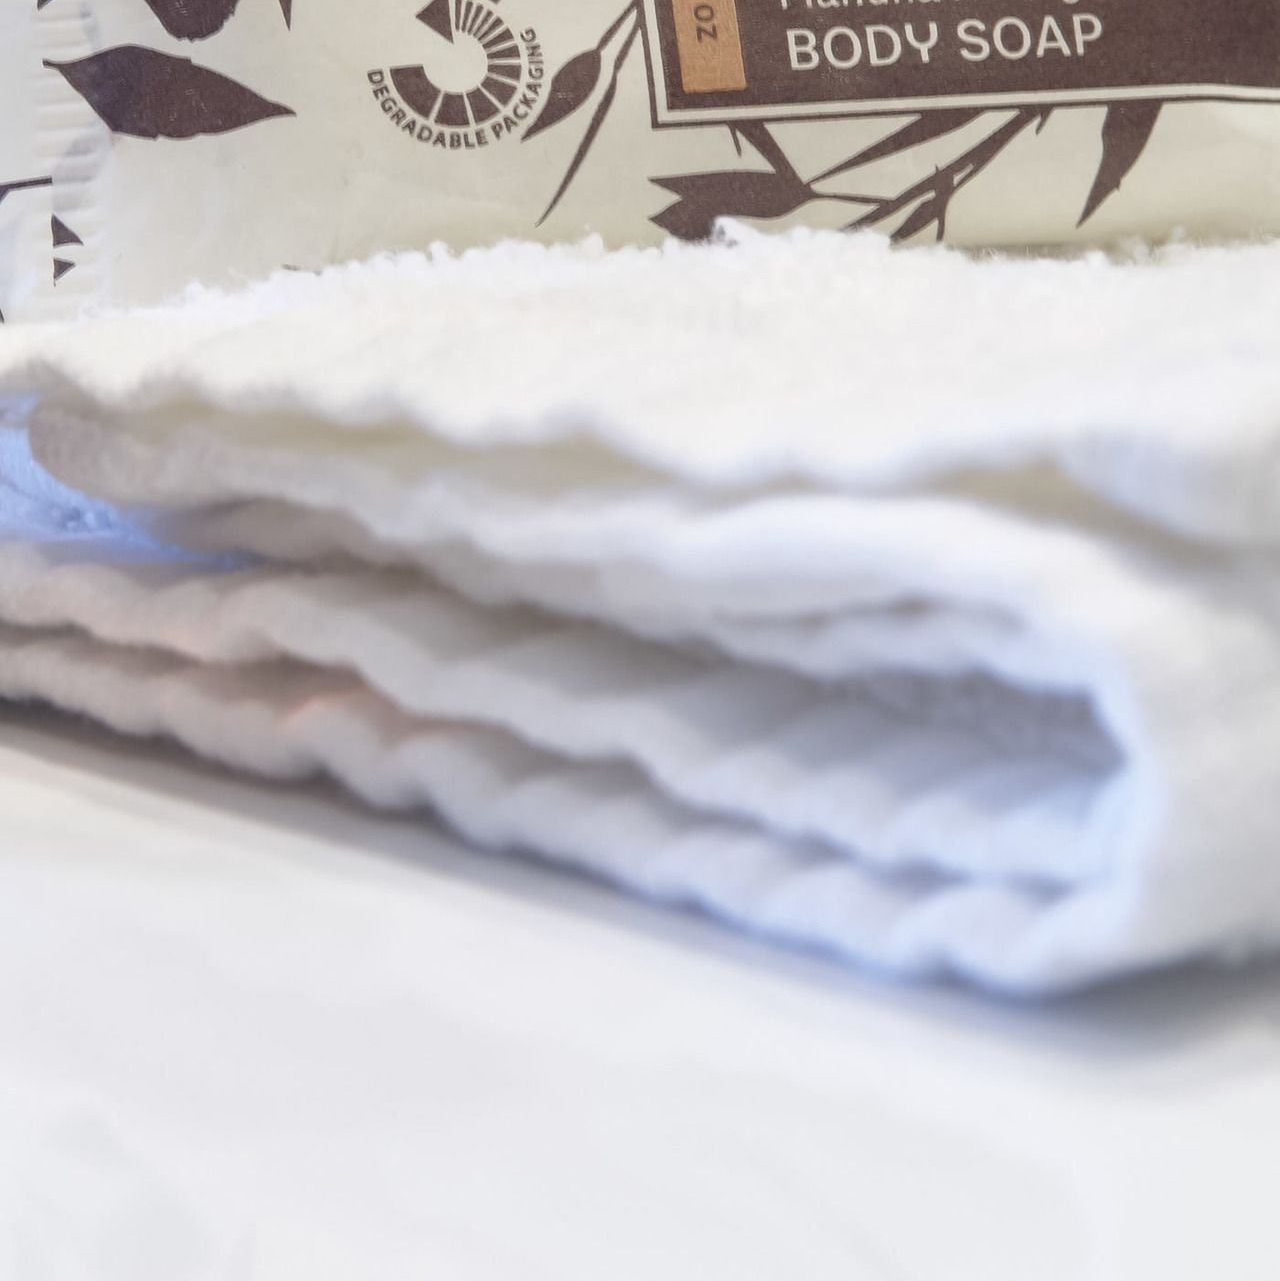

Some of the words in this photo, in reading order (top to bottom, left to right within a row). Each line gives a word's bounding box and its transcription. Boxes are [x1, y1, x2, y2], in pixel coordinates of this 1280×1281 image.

[693, 5, 718, 43] oz
[785, 21, 939, 71] BODY
[956, 13, 1104, 62] SOAP
[367, 68, 489, 150] DEGRADABLE
[489, 27, 545, 141] PACKAGING
